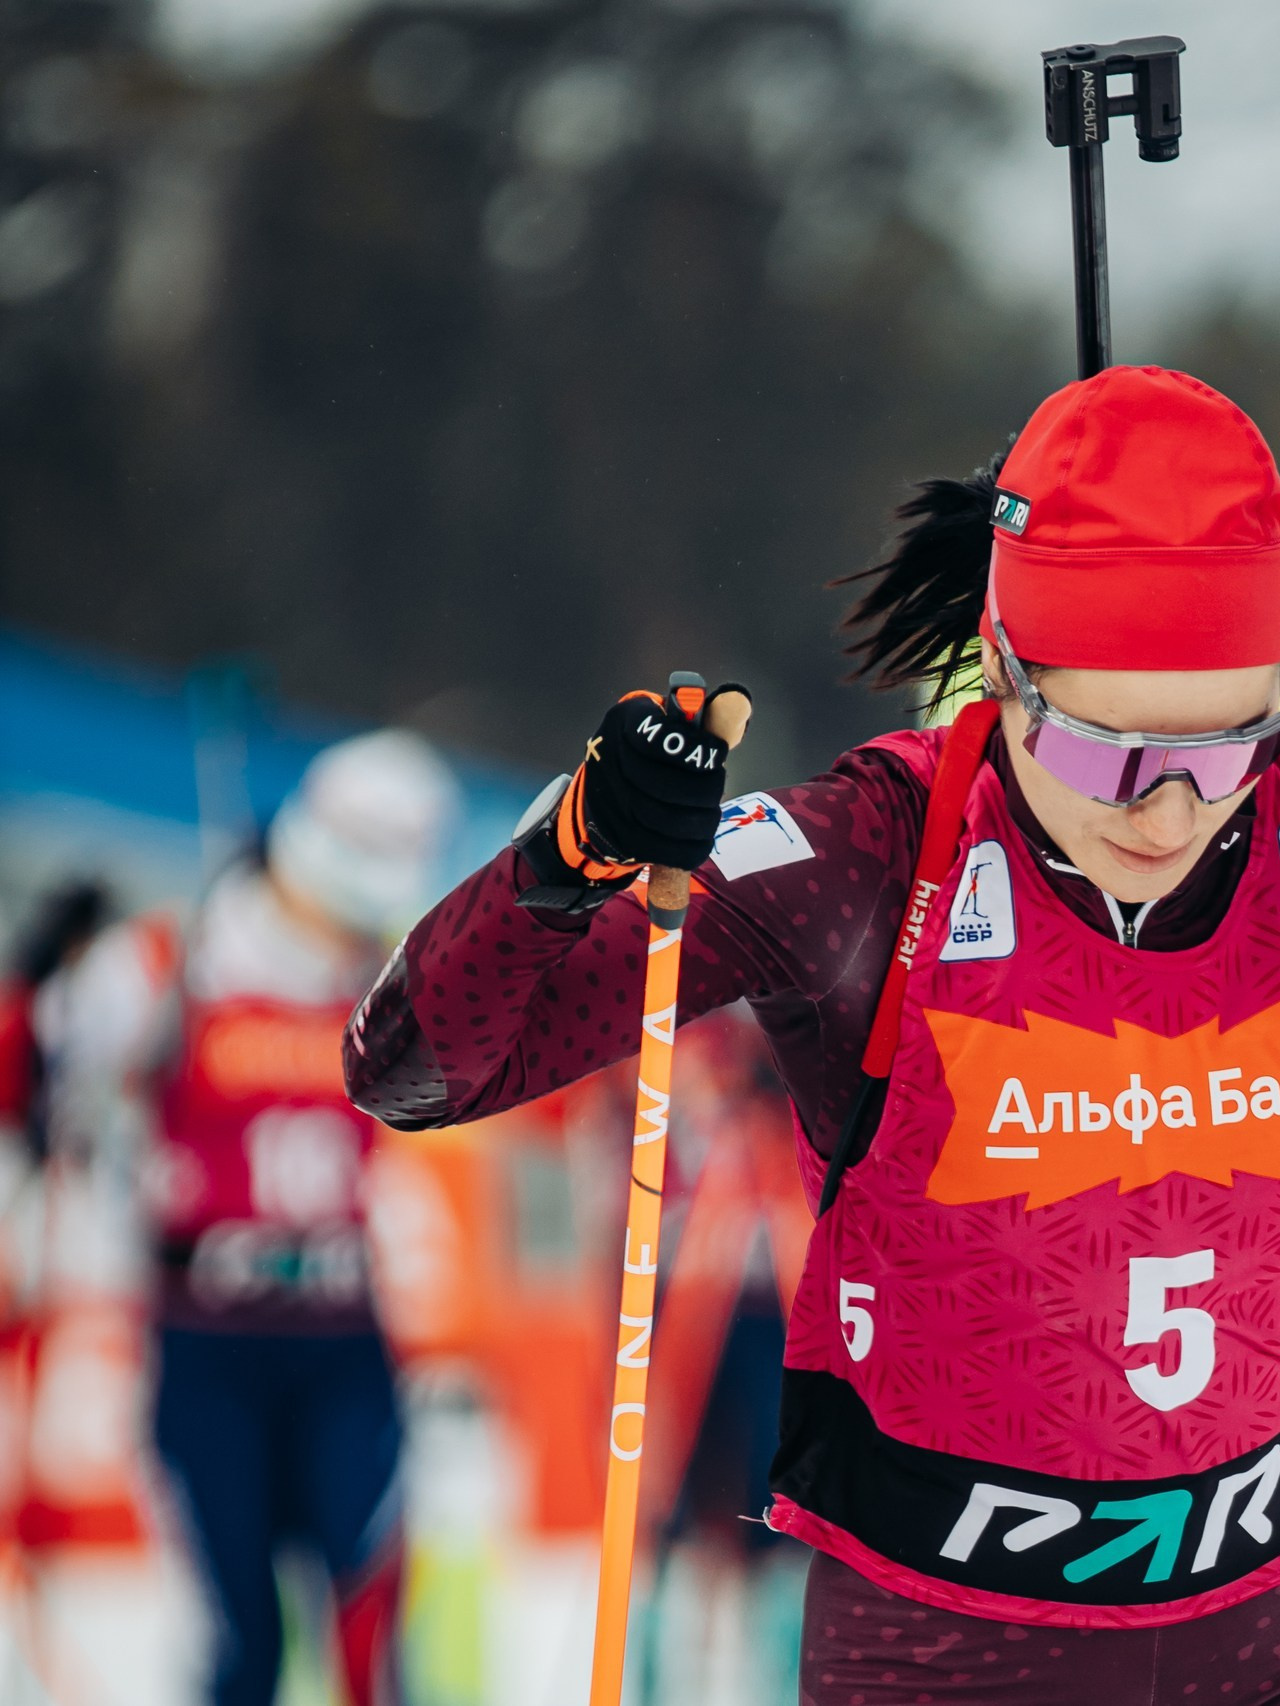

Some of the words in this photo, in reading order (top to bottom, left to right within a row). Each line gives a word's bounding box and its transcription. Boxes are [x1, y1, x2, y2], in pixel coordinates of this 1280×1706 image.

[1081, 69, 1098, 142] ANSCHUTZ
[636, 715, 718, 770] MOAX
[897, 879, 941, 971] hiatar
[952, 930, 992, 943] СБР
[985, 1073, 1197, 1160] Альфа
[839, 1278, 875, 1362] 5
[1123, 1249, 1216, 1412] 5
